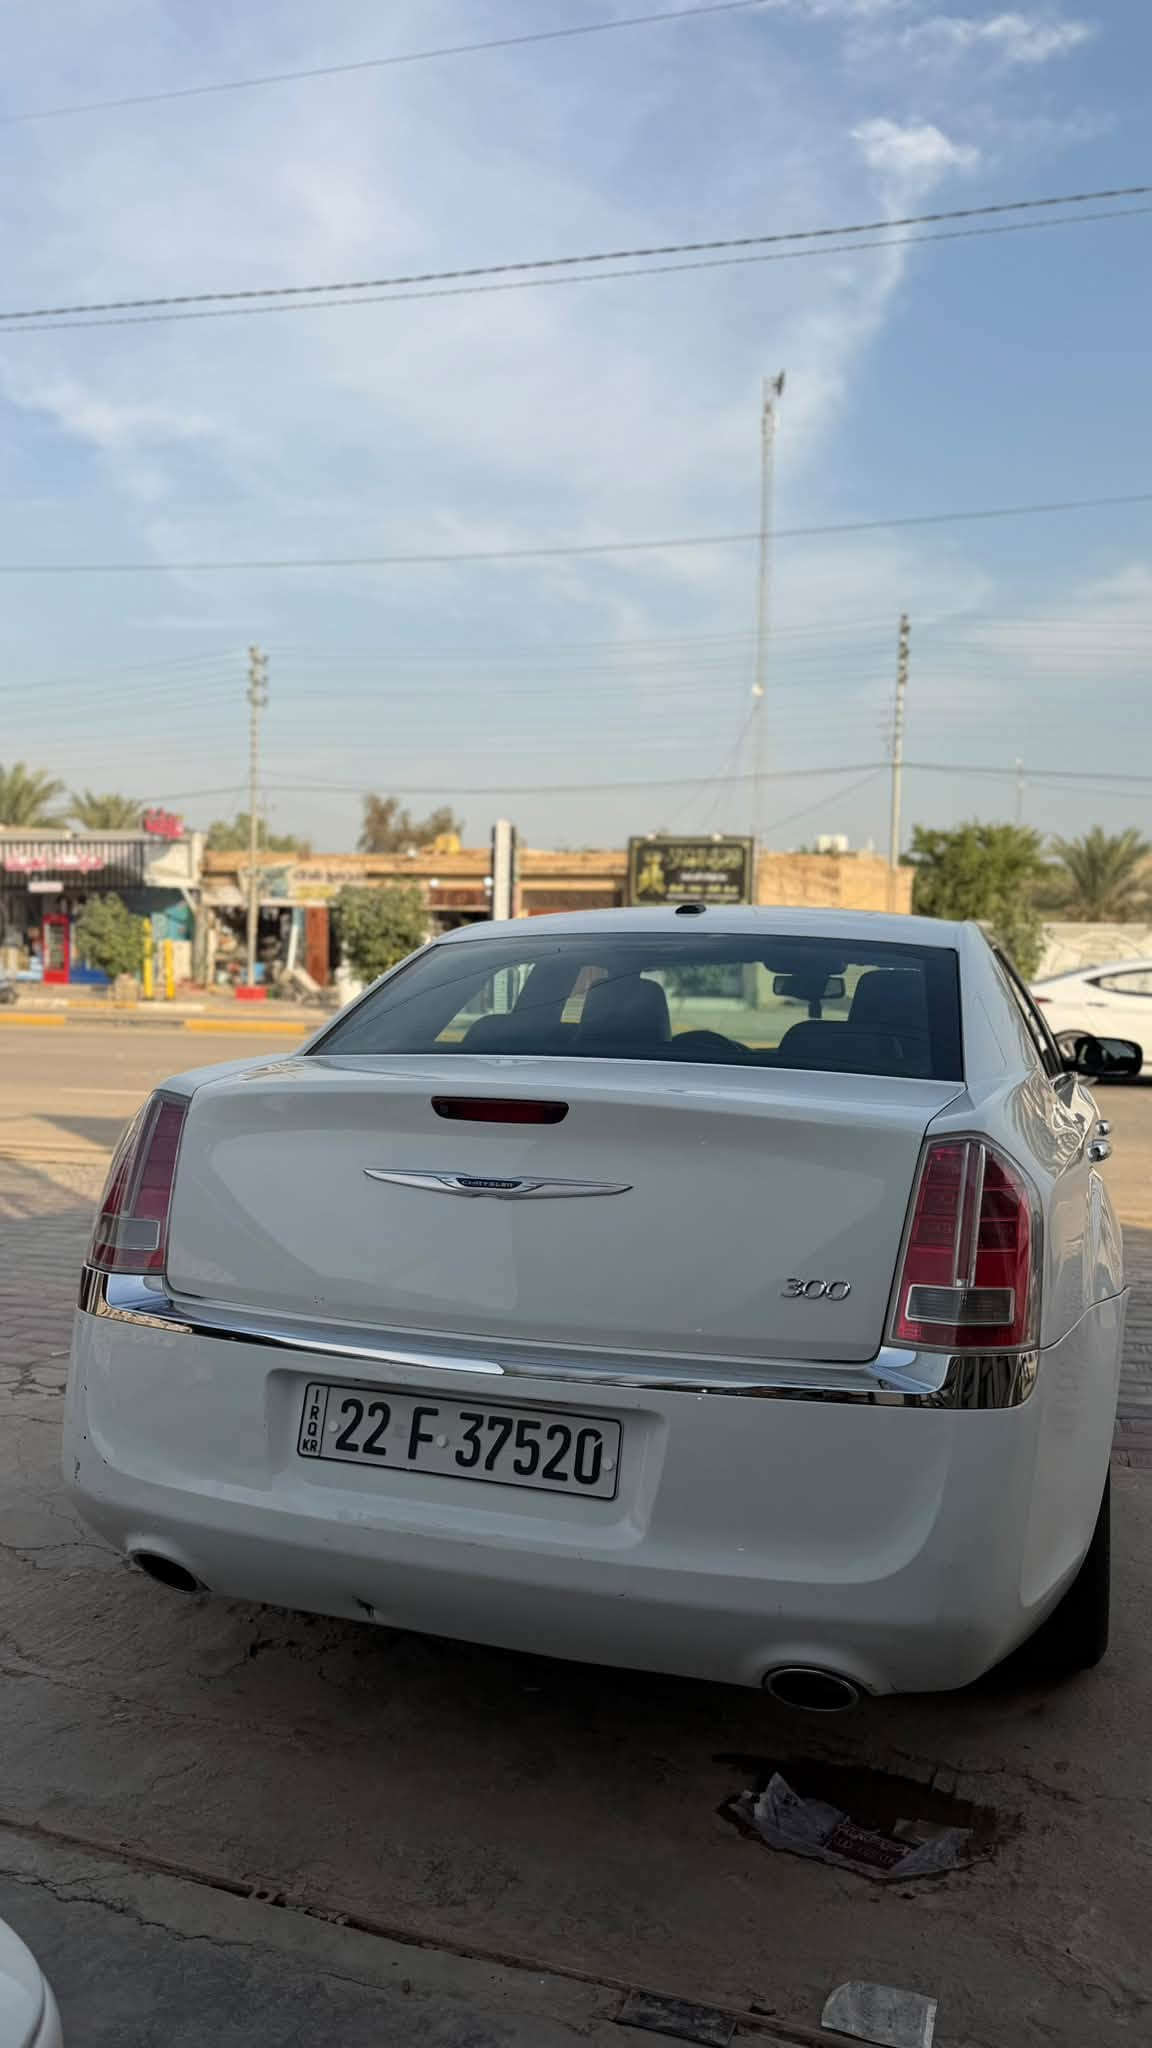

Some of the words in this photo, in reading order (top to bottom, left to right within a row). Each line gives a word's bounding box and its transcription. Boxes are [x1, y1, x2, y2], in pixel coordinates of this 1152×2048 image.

[781, 1278, 851, 1301] 300
[302, 1438, 318, 1452] KR
[335, 1398, 391, 1456] 22
[408, 1406, 440, 1460] F
[455, 1412, 603, 1485] 37520
